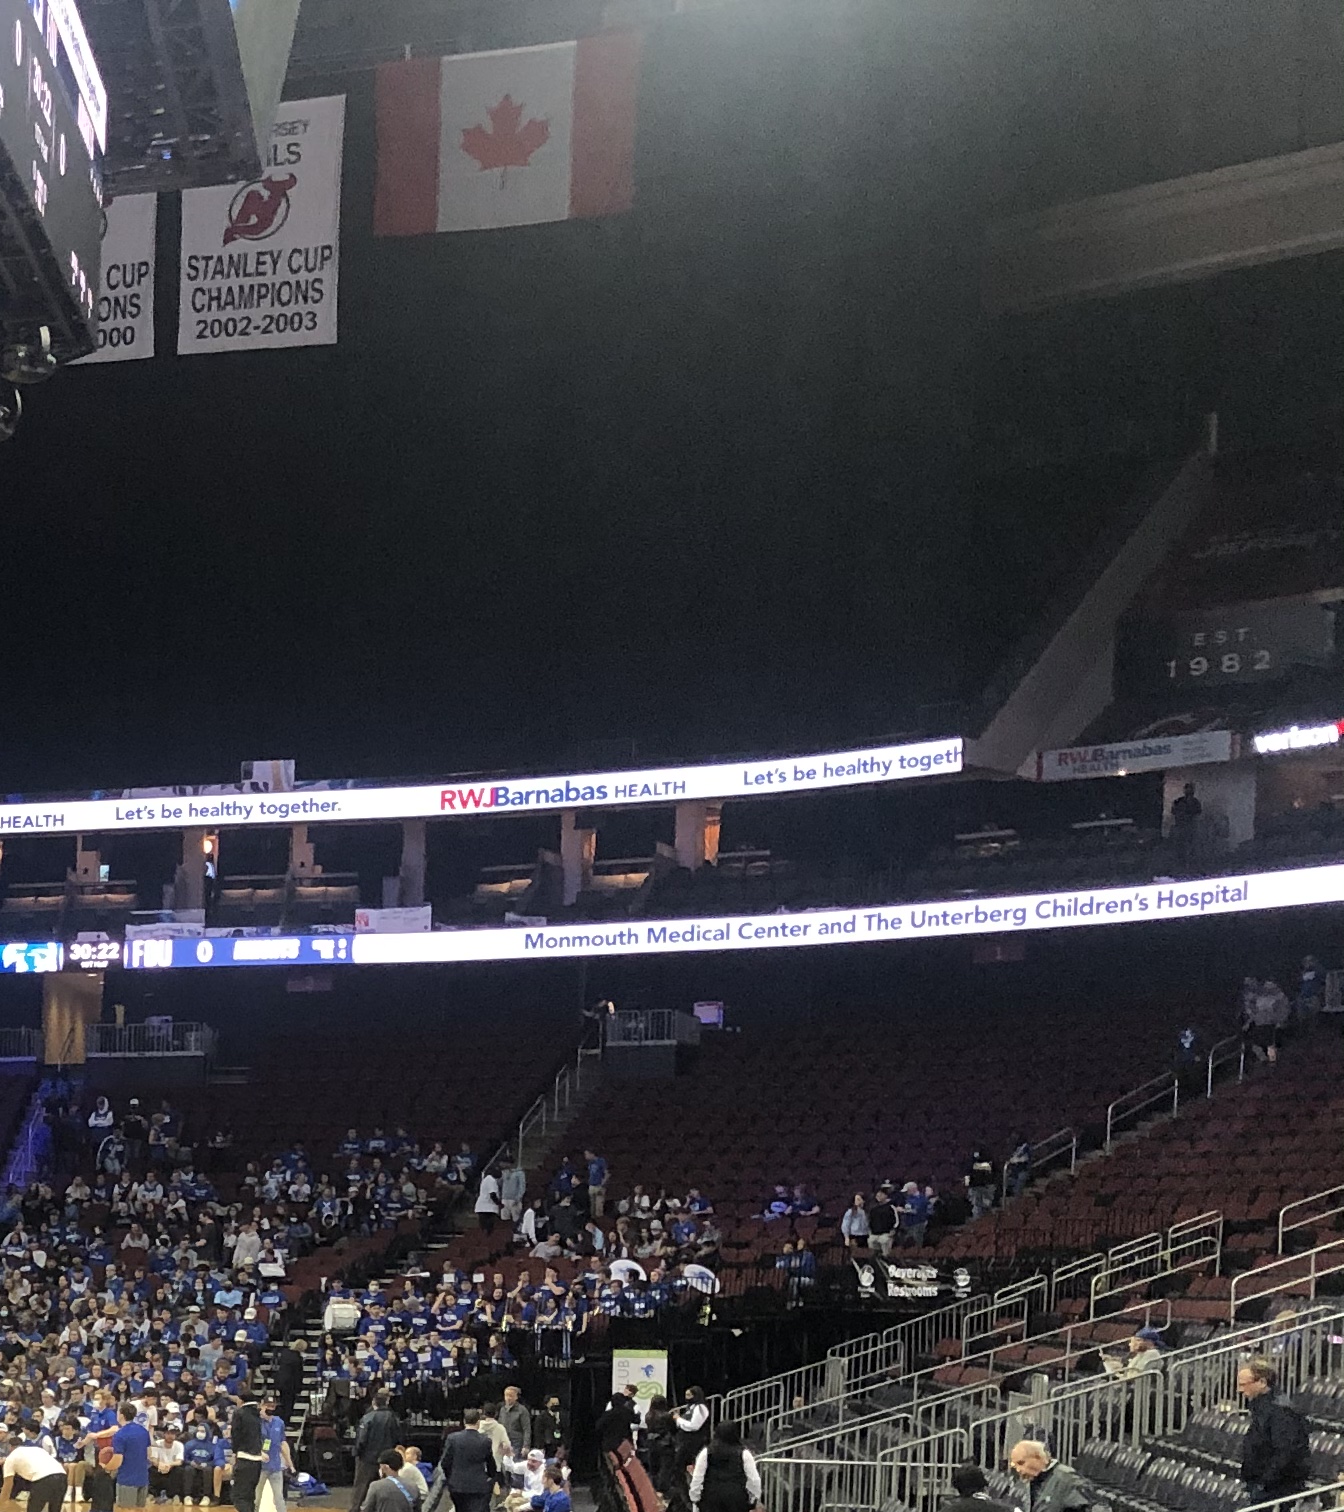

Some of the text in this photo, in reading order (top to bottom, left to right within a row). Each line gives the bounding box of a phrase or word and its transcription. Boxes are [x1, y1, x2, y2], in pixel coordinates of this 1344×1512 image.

[106, 261, 150, 290] CUP
[186, 245, 333, 282] STANLEY CUP
[192, 278, 324, 313] CHAMPIONS
[196, 311, 318, 339] 2002-2003
[1167, 650, 1272, 678] 1982
[1254, 724, 1339, 753] verizon
[743, 767, 788, 786] Let's
[793, 765, 817, 782] be
[823, 756, 893, 779] healthy
[614, 780, 686, 799] HEALTH
[0, 813, 65, 830] HEALTH
[115, 797, 342, 821] Let's be healthy together.
[524, 880, 1249, 950] Monmouth Medical Center and The Unterberg Children's Hospital
[69, 942, 120, 960] 30:22
[887, 1283, 938, 1297] Restrooms
